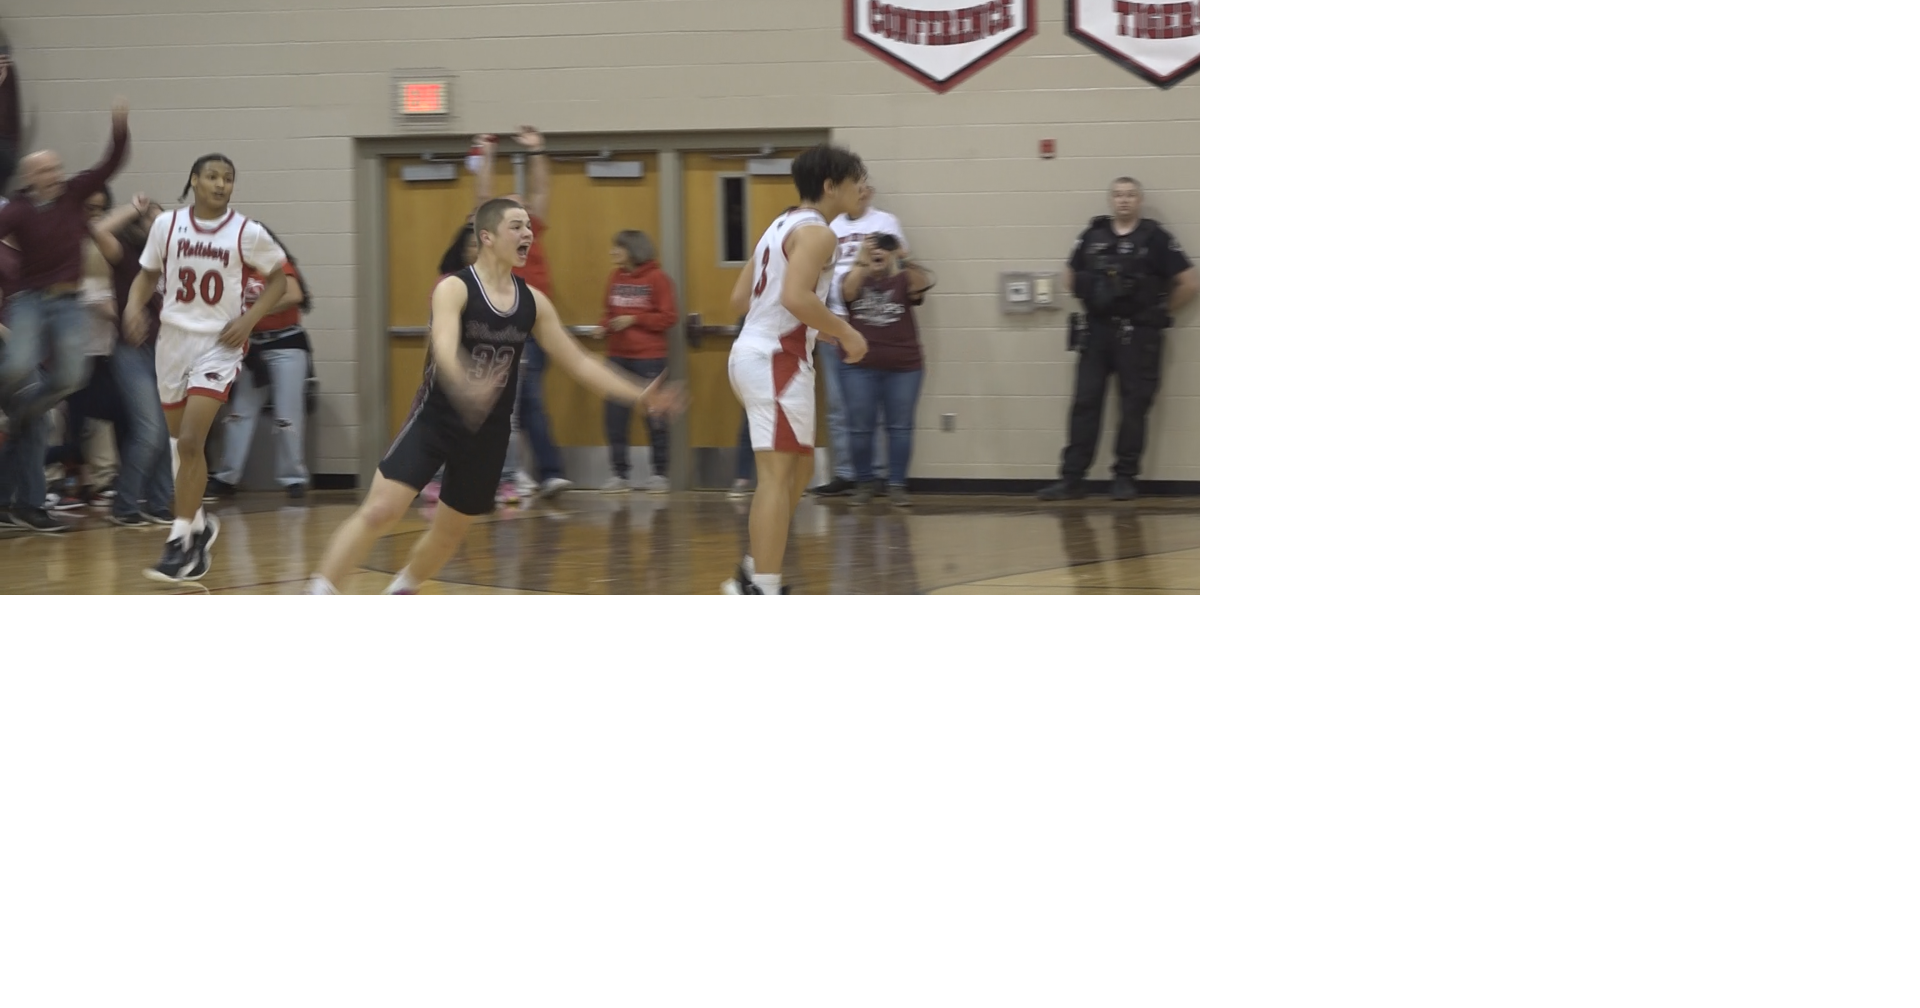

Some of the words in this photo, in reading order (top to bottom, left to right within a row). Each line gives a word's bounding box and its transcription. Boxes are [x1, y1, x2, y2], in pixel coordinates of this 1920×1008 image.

[868, 0, 1015, 46] CONFERENCE
[176, 266, 225, 306] 30
[754, 246, 770, 298] 3
[467, 343, 515, 388] 32
